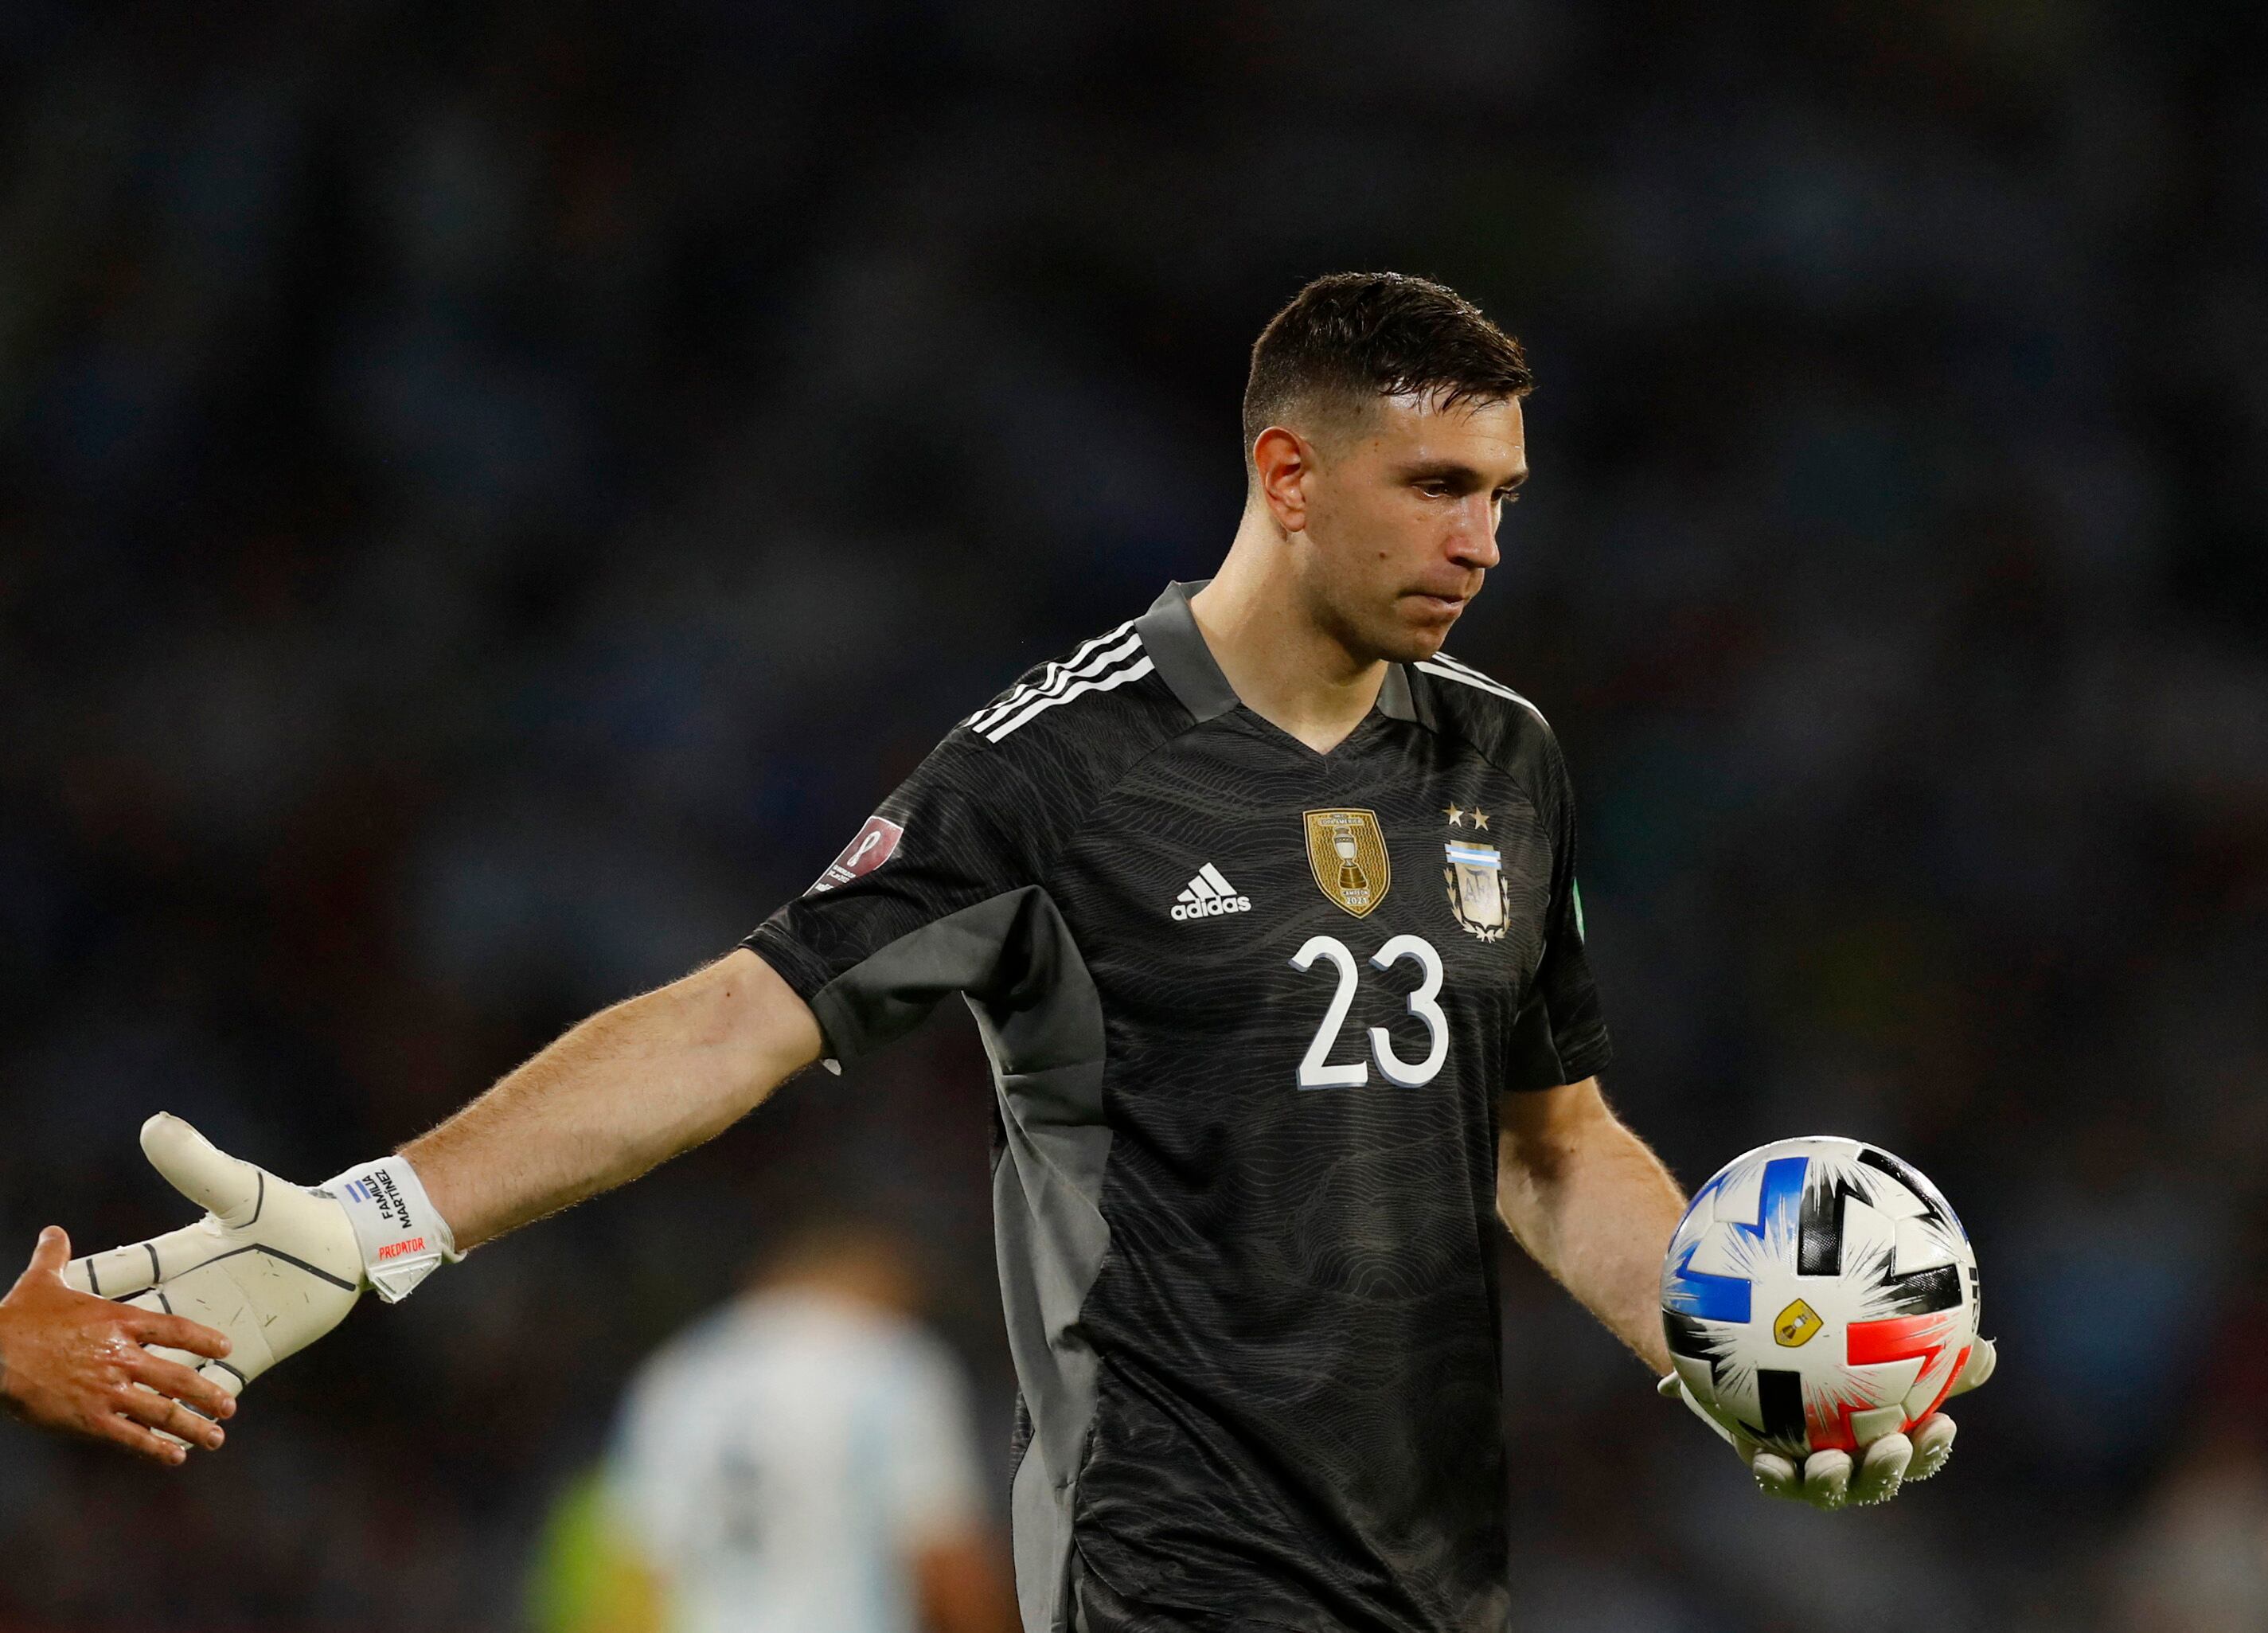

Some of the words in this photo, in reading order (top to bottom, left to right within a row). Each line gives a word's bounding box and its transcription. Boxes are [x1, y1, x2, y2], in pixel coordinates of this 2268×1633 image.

[1170, 896, 1251, 920] adidas
[1287, 934, 1449, 1091] 23
[362, 1175, 393, 1220] FAMILIA
[375, 1169, 412, 1229] MARTÍNEZ
[378, 1237, 425, 1261] PREDATOR
